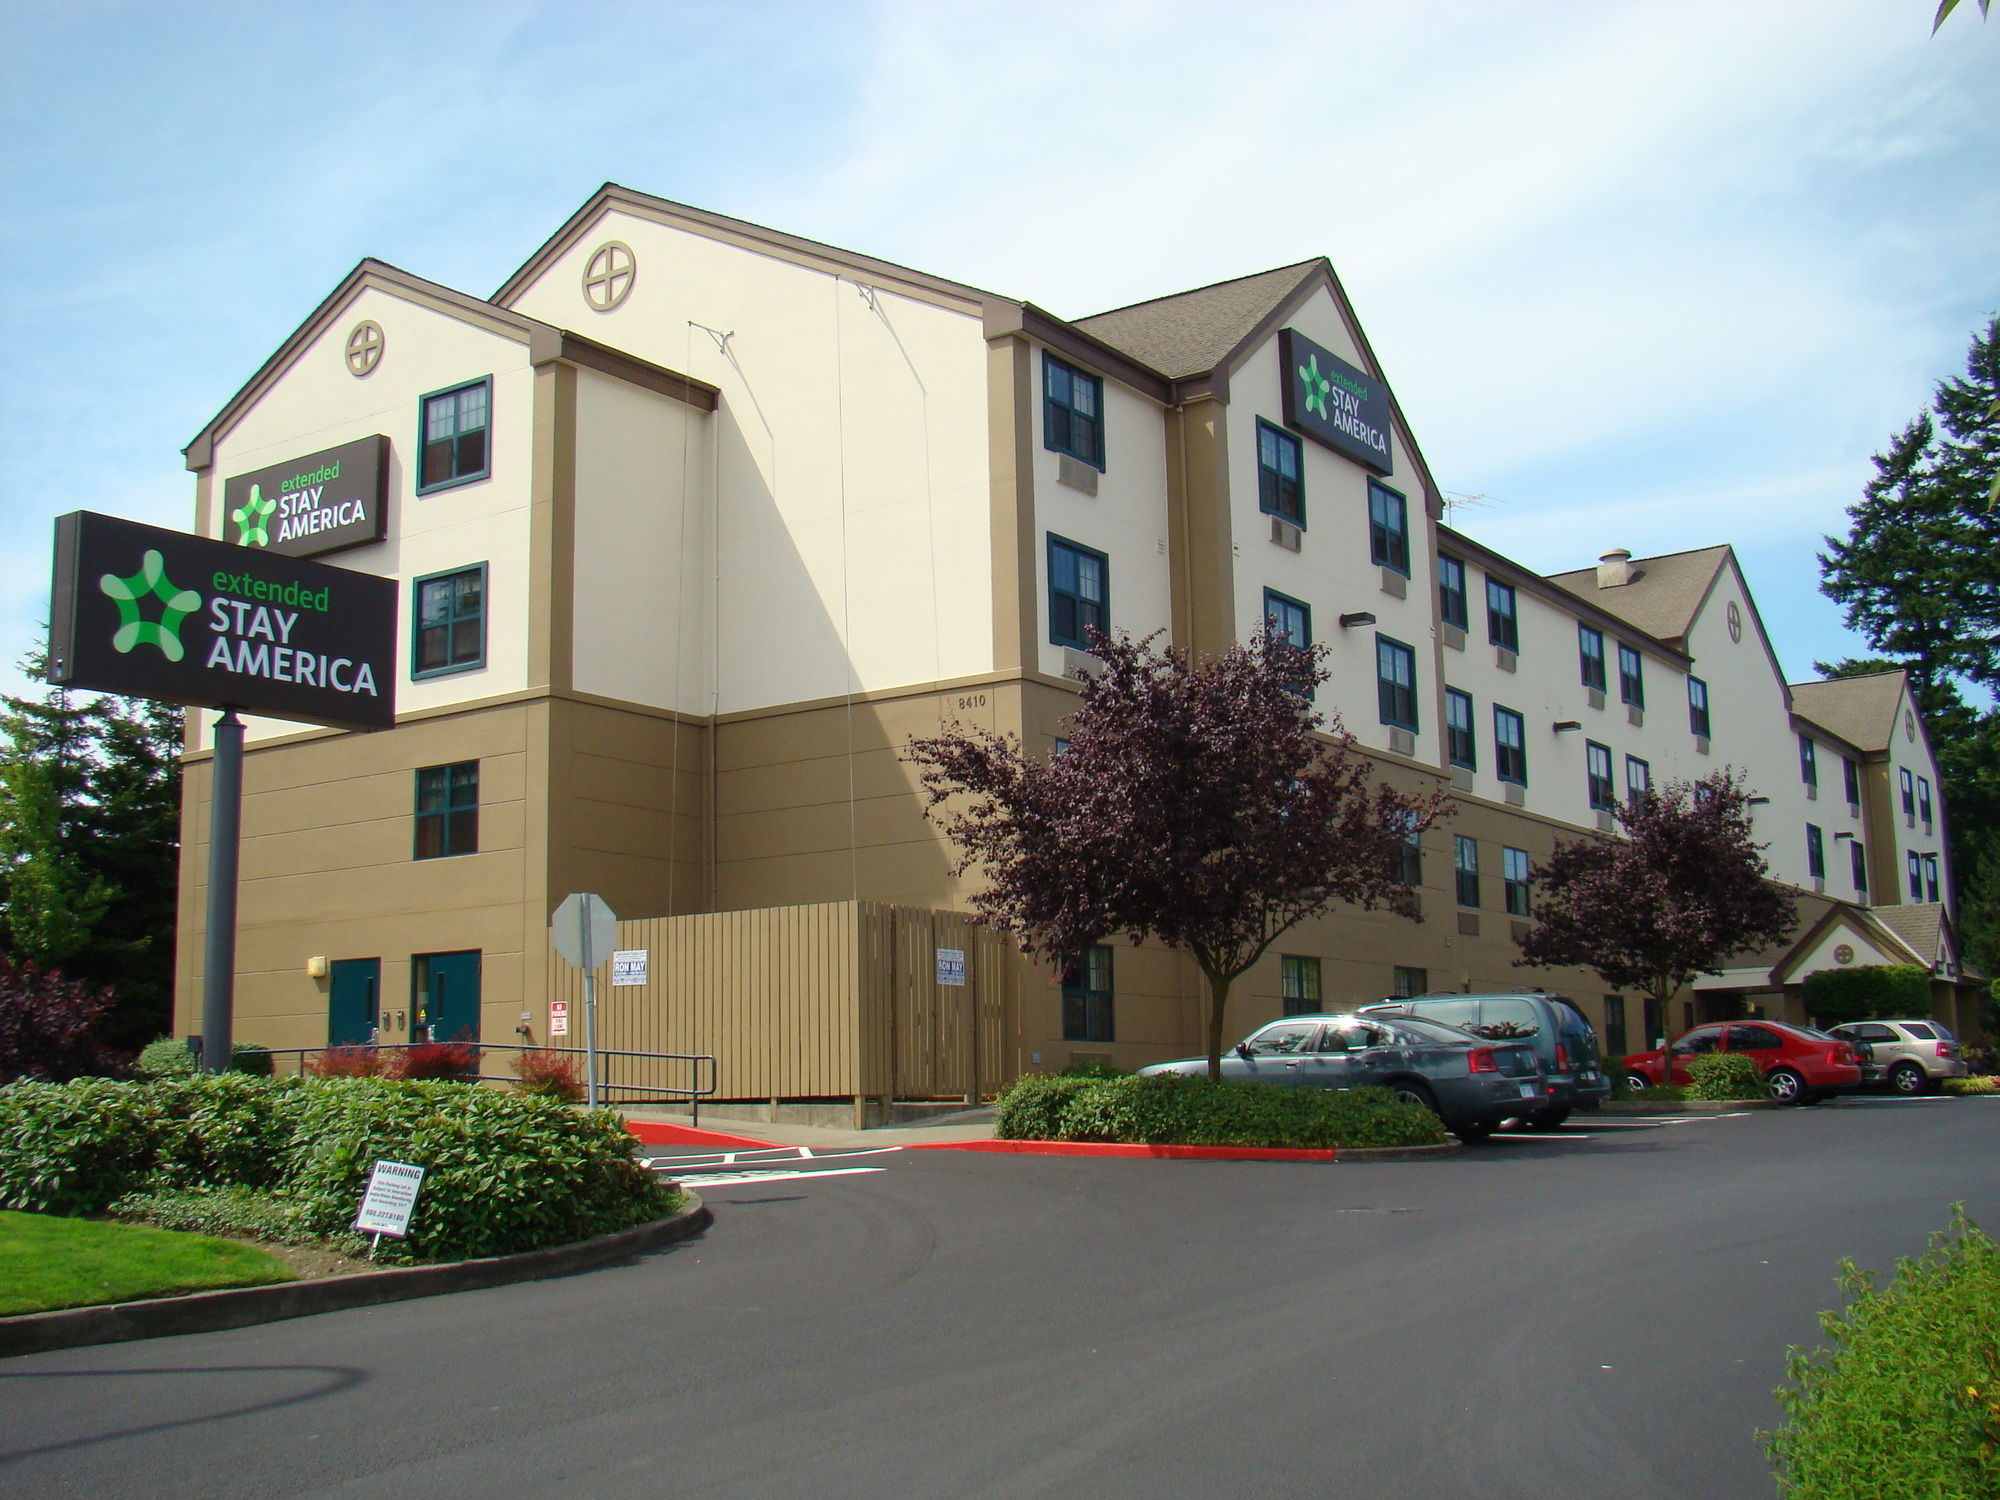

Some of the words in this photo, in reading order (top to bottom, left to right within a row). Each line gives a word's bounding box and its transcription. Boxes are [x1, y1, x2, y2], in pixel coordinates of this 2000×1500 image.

[1330, 371, 1368, 401] extended
[1331, 385, 1359, 417] STAY
[1333, 408, 1387, 455] AMERICA
[281, 460, 340, 493] extended
[279, 485, 324, 519] STAY
[277, 499, 366, 543] AMERICA
[212, 571, 329, 612] extended
[209, 596, 299, 644] STAY
[206, 635, 378, 697] AMERICA
[958, 693, 986, 710] 8410
[614, 961, 630, 972] RON
[630, 961, 645, 972] MAY
[378, 1164, 421, 1180] WARNING
